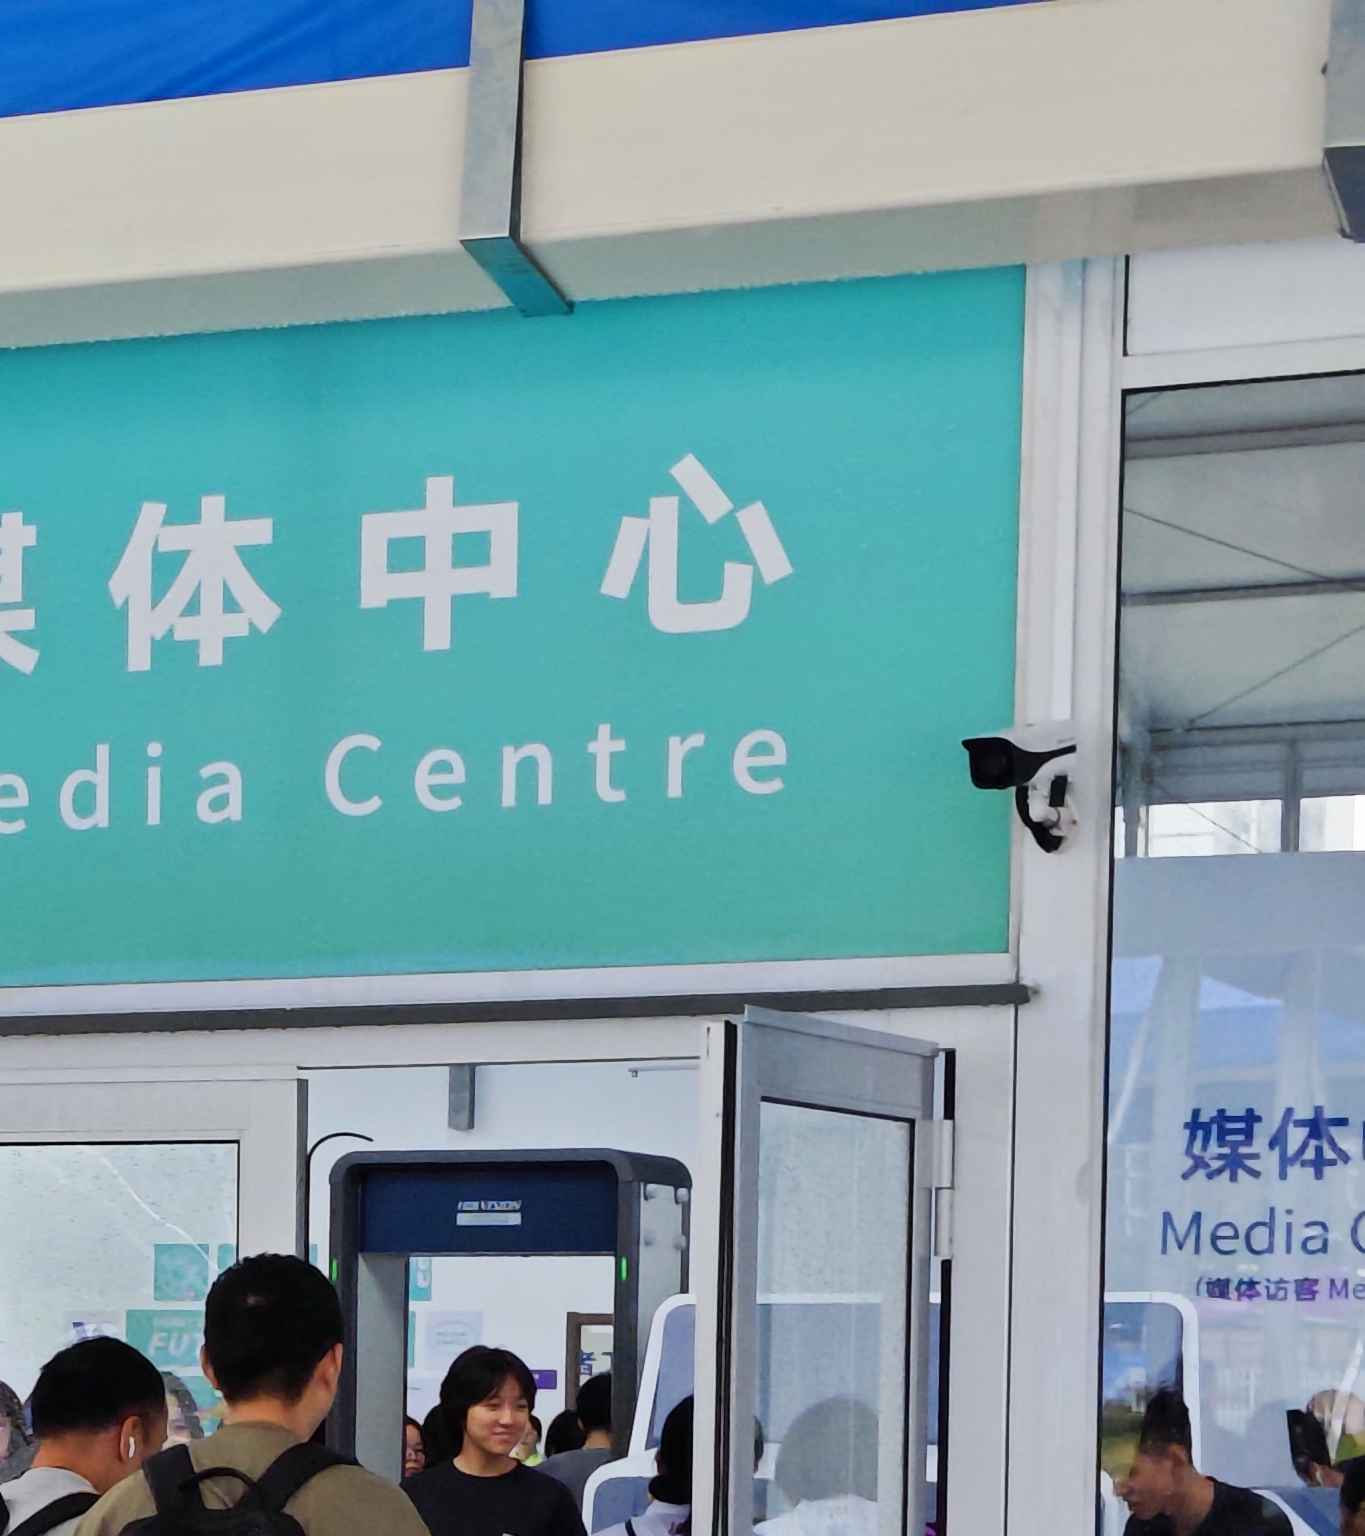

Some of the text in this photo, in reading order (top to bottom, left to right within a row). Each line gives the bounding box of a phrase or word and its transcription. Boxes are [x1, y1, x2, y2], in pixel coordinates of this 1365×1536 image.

[323, 723, 792, 818] Centre
[1180, 1105, 1365, 1183] 媒体
[1159, 1206, 1330, 1256] Media
